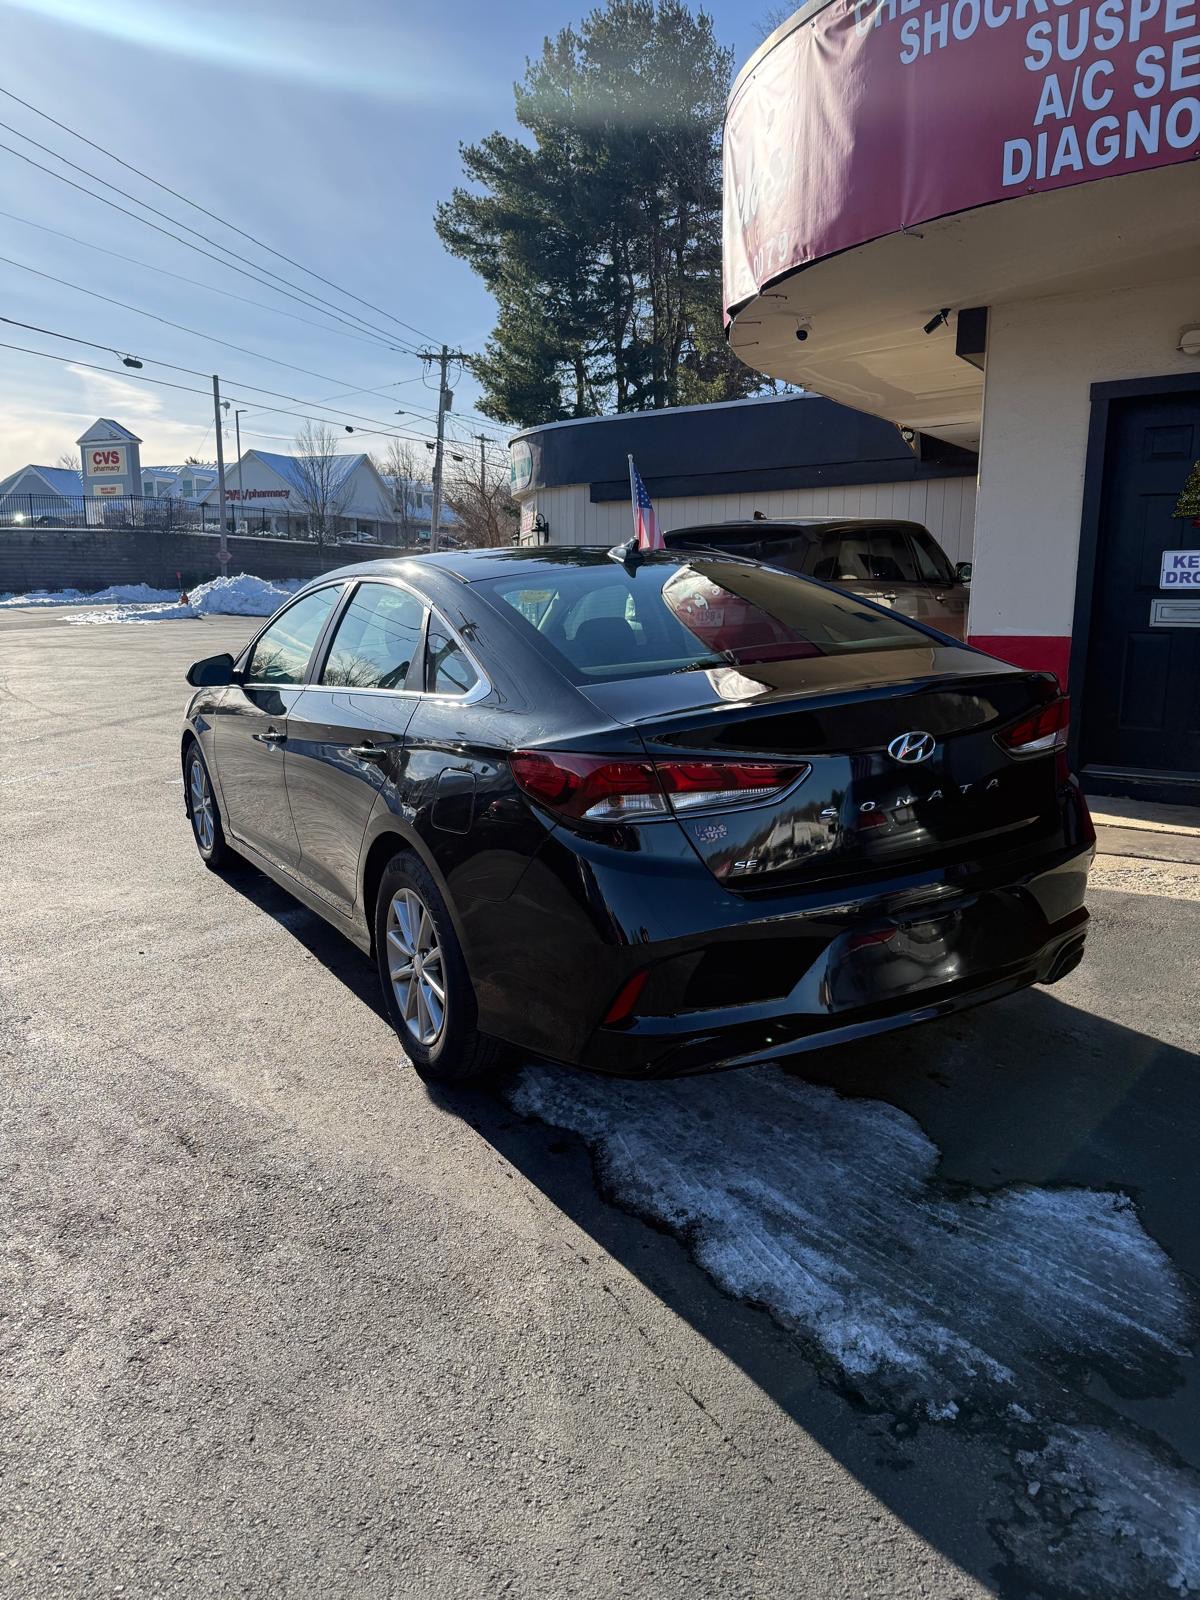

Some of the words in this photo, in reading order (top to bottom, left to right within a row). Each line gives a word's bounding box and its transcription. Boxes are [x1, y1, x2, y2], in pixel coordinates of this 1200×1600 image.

[899, 0, 1071, 65] SHOC
[1033, 59, 1115, 126] A/C
[1002, 96, 1200, 187] DIAGNO
[93, 451, 120, 465] CVS
[93, 465, 120, 473] pharmacy
[819, 778, 1000, 821] SONATA
[733, 860, 758, 870] SE
